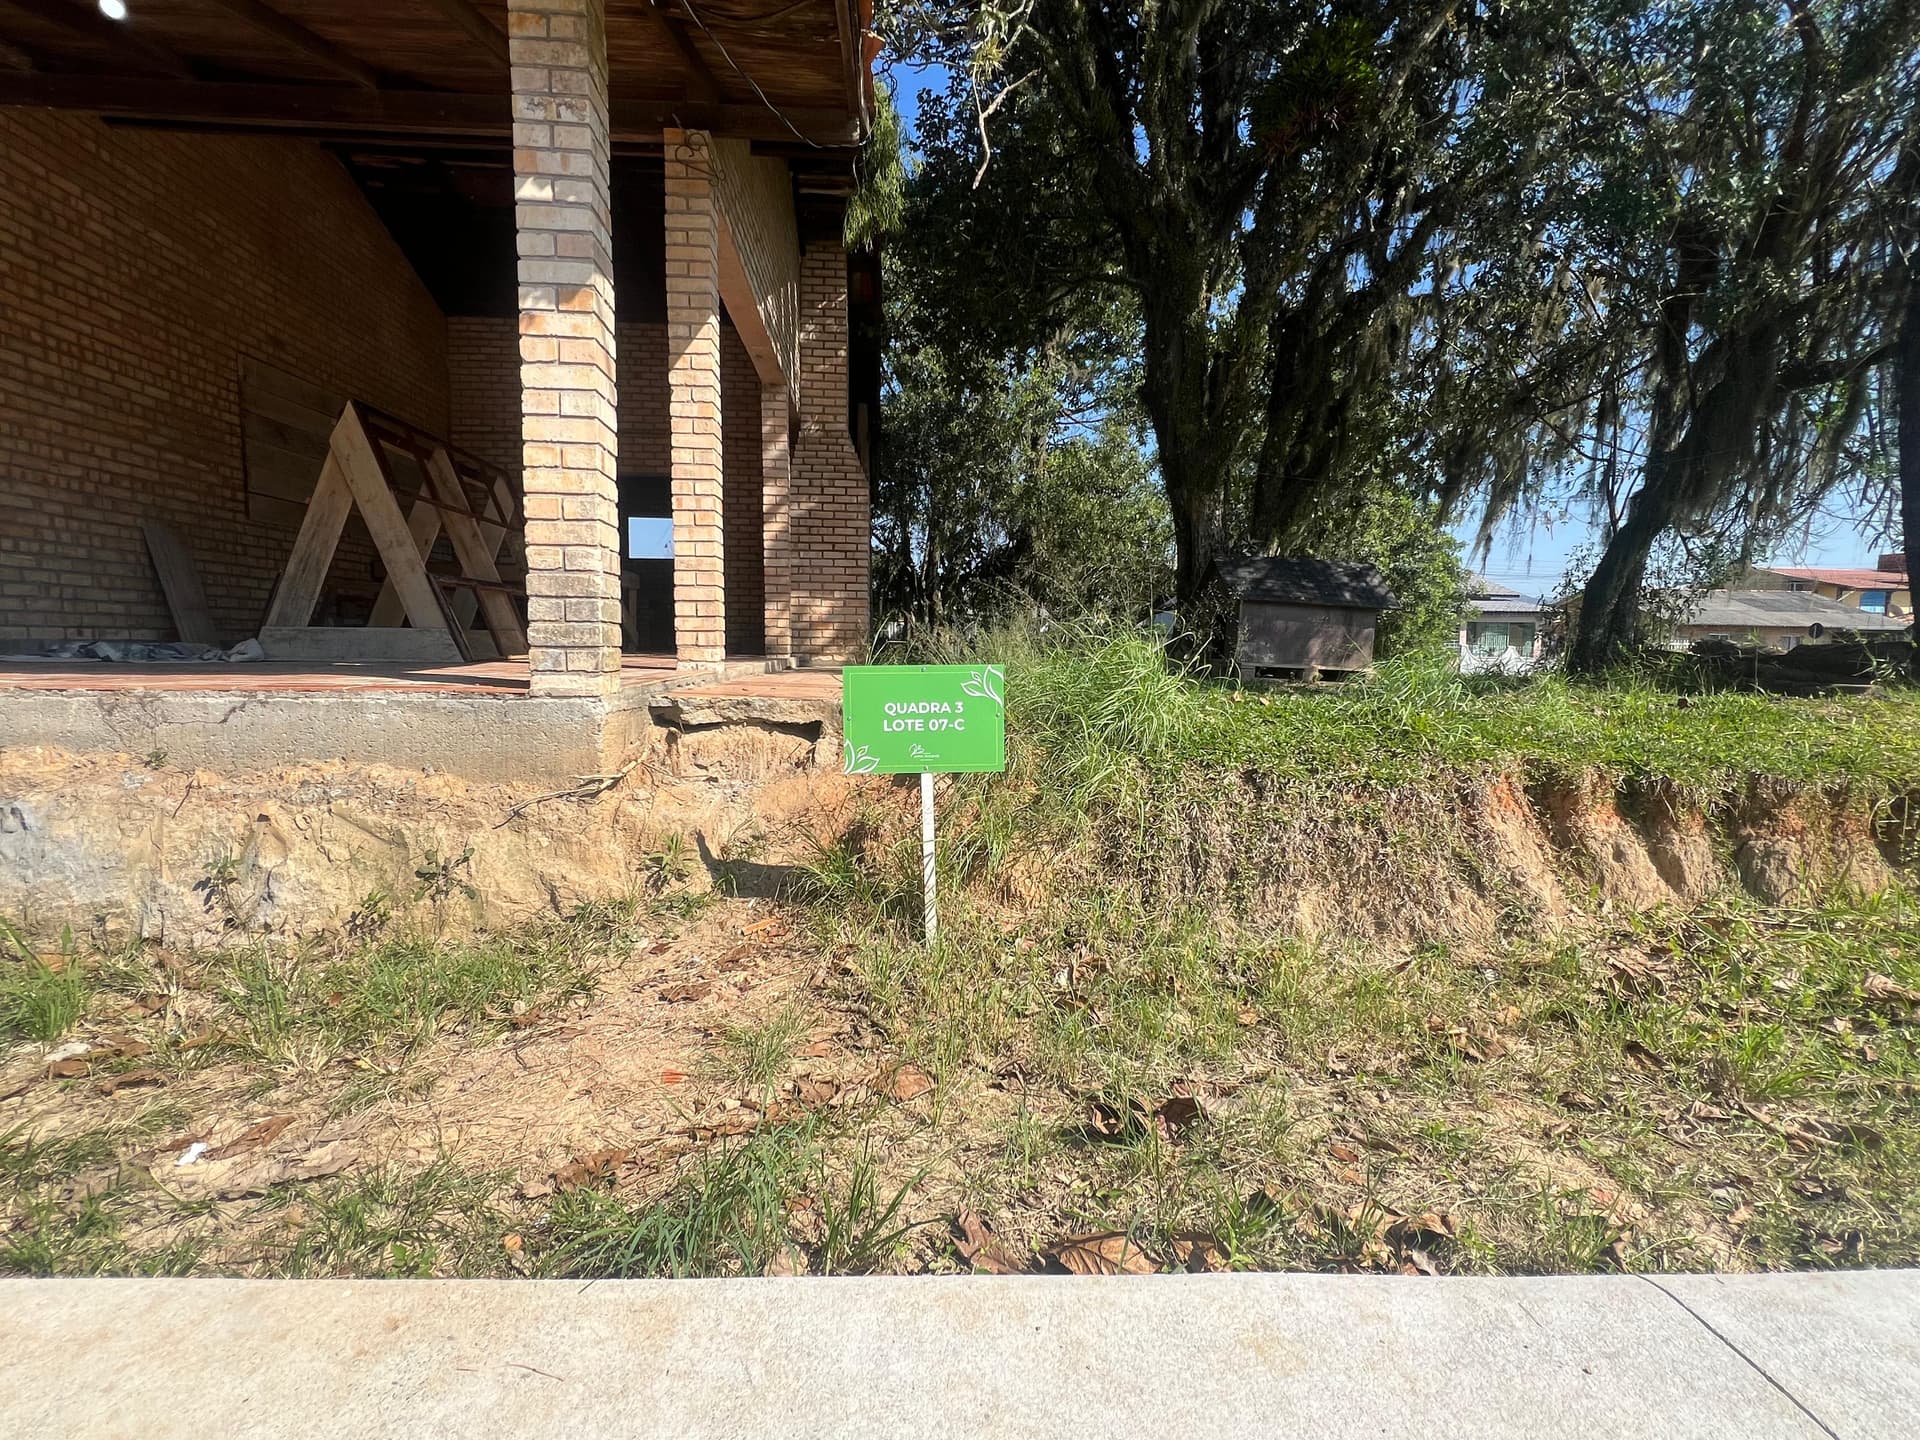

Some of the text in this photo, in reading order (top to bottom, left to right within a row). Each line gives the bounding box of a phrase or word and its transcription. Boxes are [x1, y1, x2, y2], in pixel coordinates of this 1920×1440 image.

[884, 701, 964, 716] QUADRA 3
[883, 718, 965, 732] LOTE 07-C
